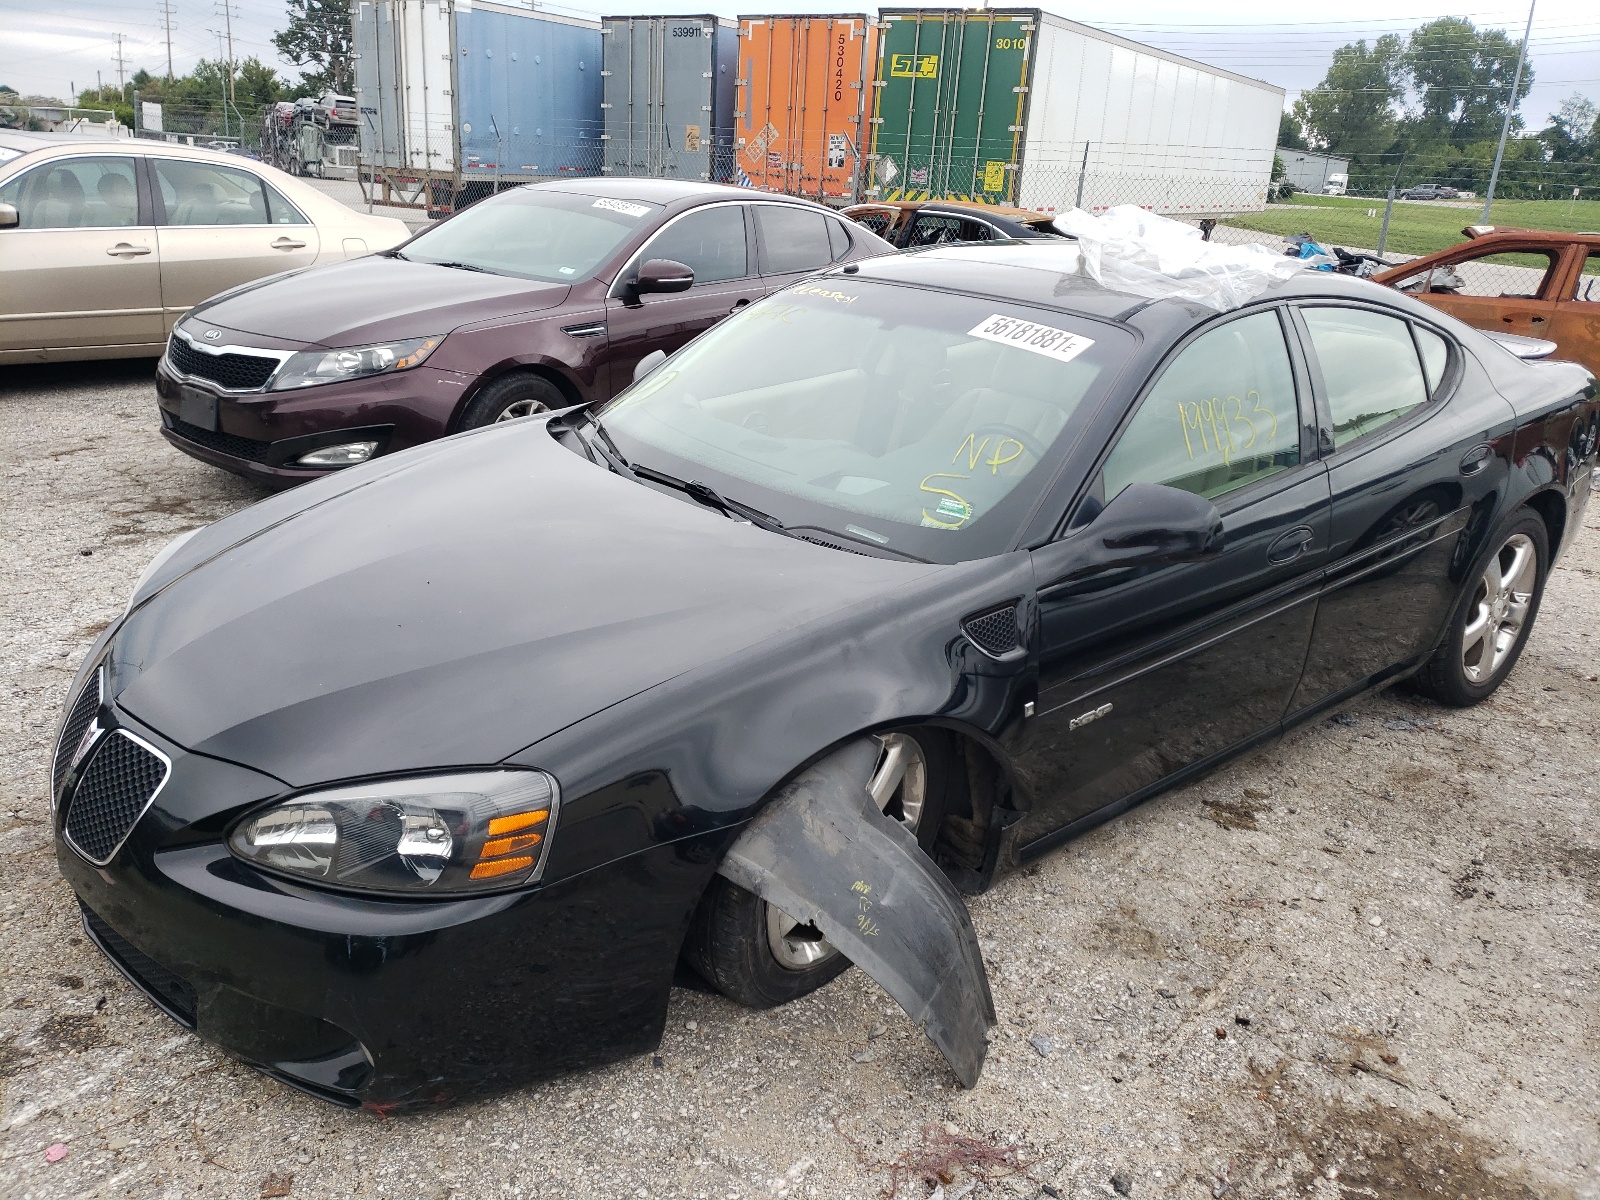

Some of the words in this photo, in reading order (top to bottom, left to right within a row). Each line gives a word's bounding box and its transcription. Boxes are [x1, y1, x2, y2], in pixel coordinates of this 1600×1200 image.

[672, 27, 701, 37] 539911
[995, 38, 1026, 50] 3010
[834, 33, 846, 102] 530420
